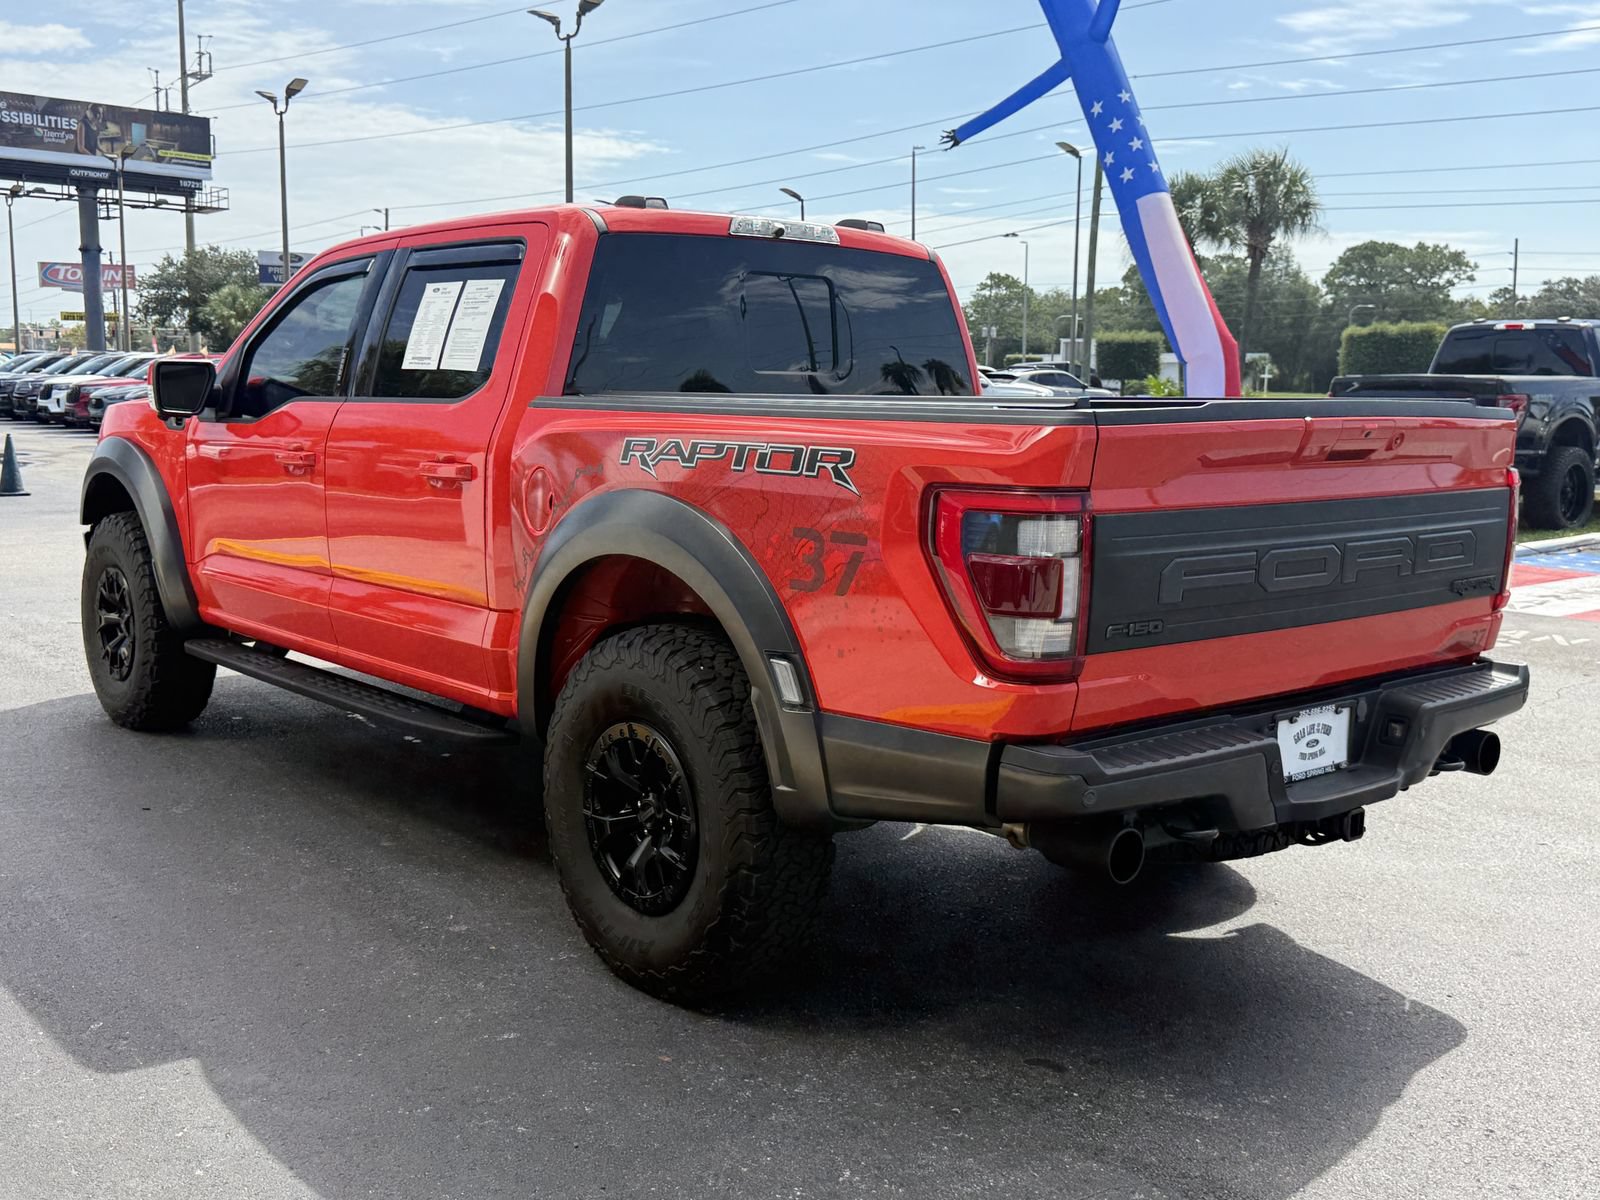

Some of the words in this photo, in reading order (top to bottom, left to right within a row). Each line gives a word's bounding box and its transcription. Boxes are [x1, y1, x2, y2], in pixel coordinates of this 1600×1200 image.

[0, 110, 78, 131] SSIBILITIES
[619, 437, 862, 499] RAPTOR
[788, 527, 868, 597] 37
[1158, 529, 1477, 605] FORD
[1105, 618, 1164, 640] F-150
[1292, 772, 1306, 782] FORD
[1307, 768, 1324, 777] SPRING
